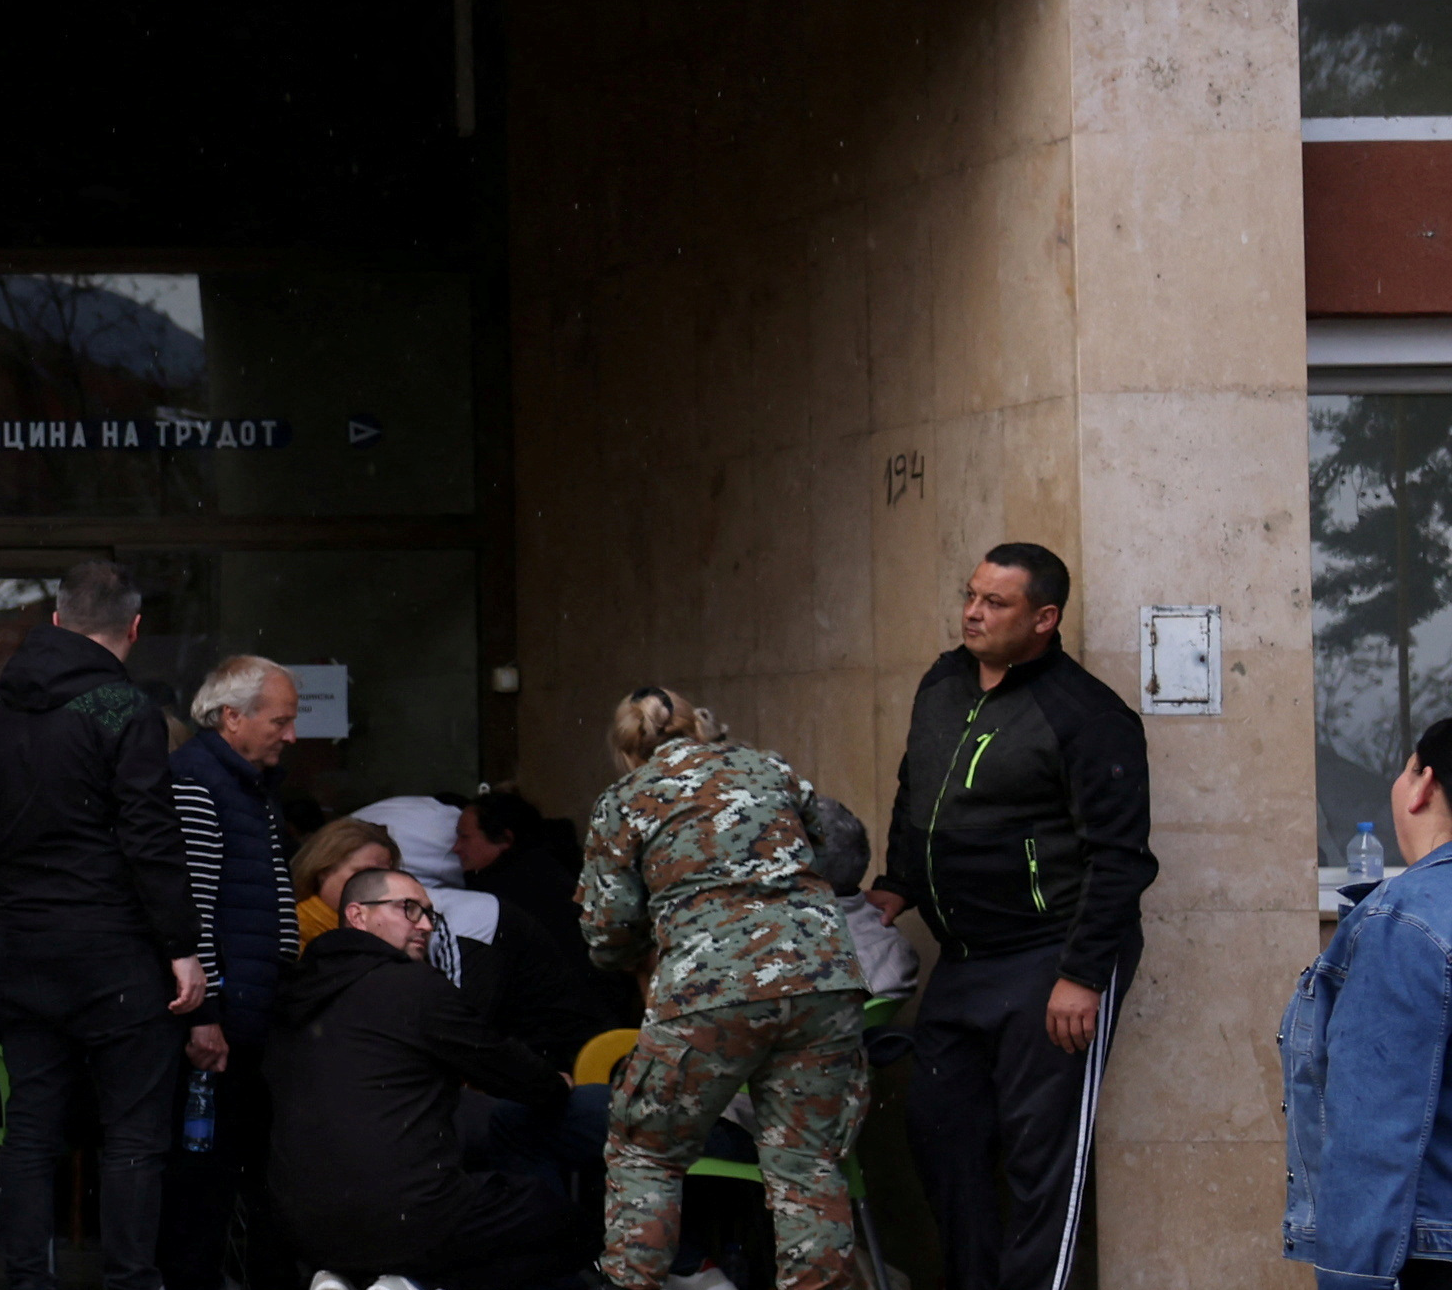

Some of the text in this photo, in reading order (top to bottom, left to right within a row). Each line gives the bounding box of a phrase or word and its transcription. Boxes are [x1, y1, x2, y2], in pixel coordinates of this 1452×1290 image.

[102, 421, 138, 447] НА
[155, 420, 276, 448] ТРУДОТ
[884, 450, 925, 507] 194
